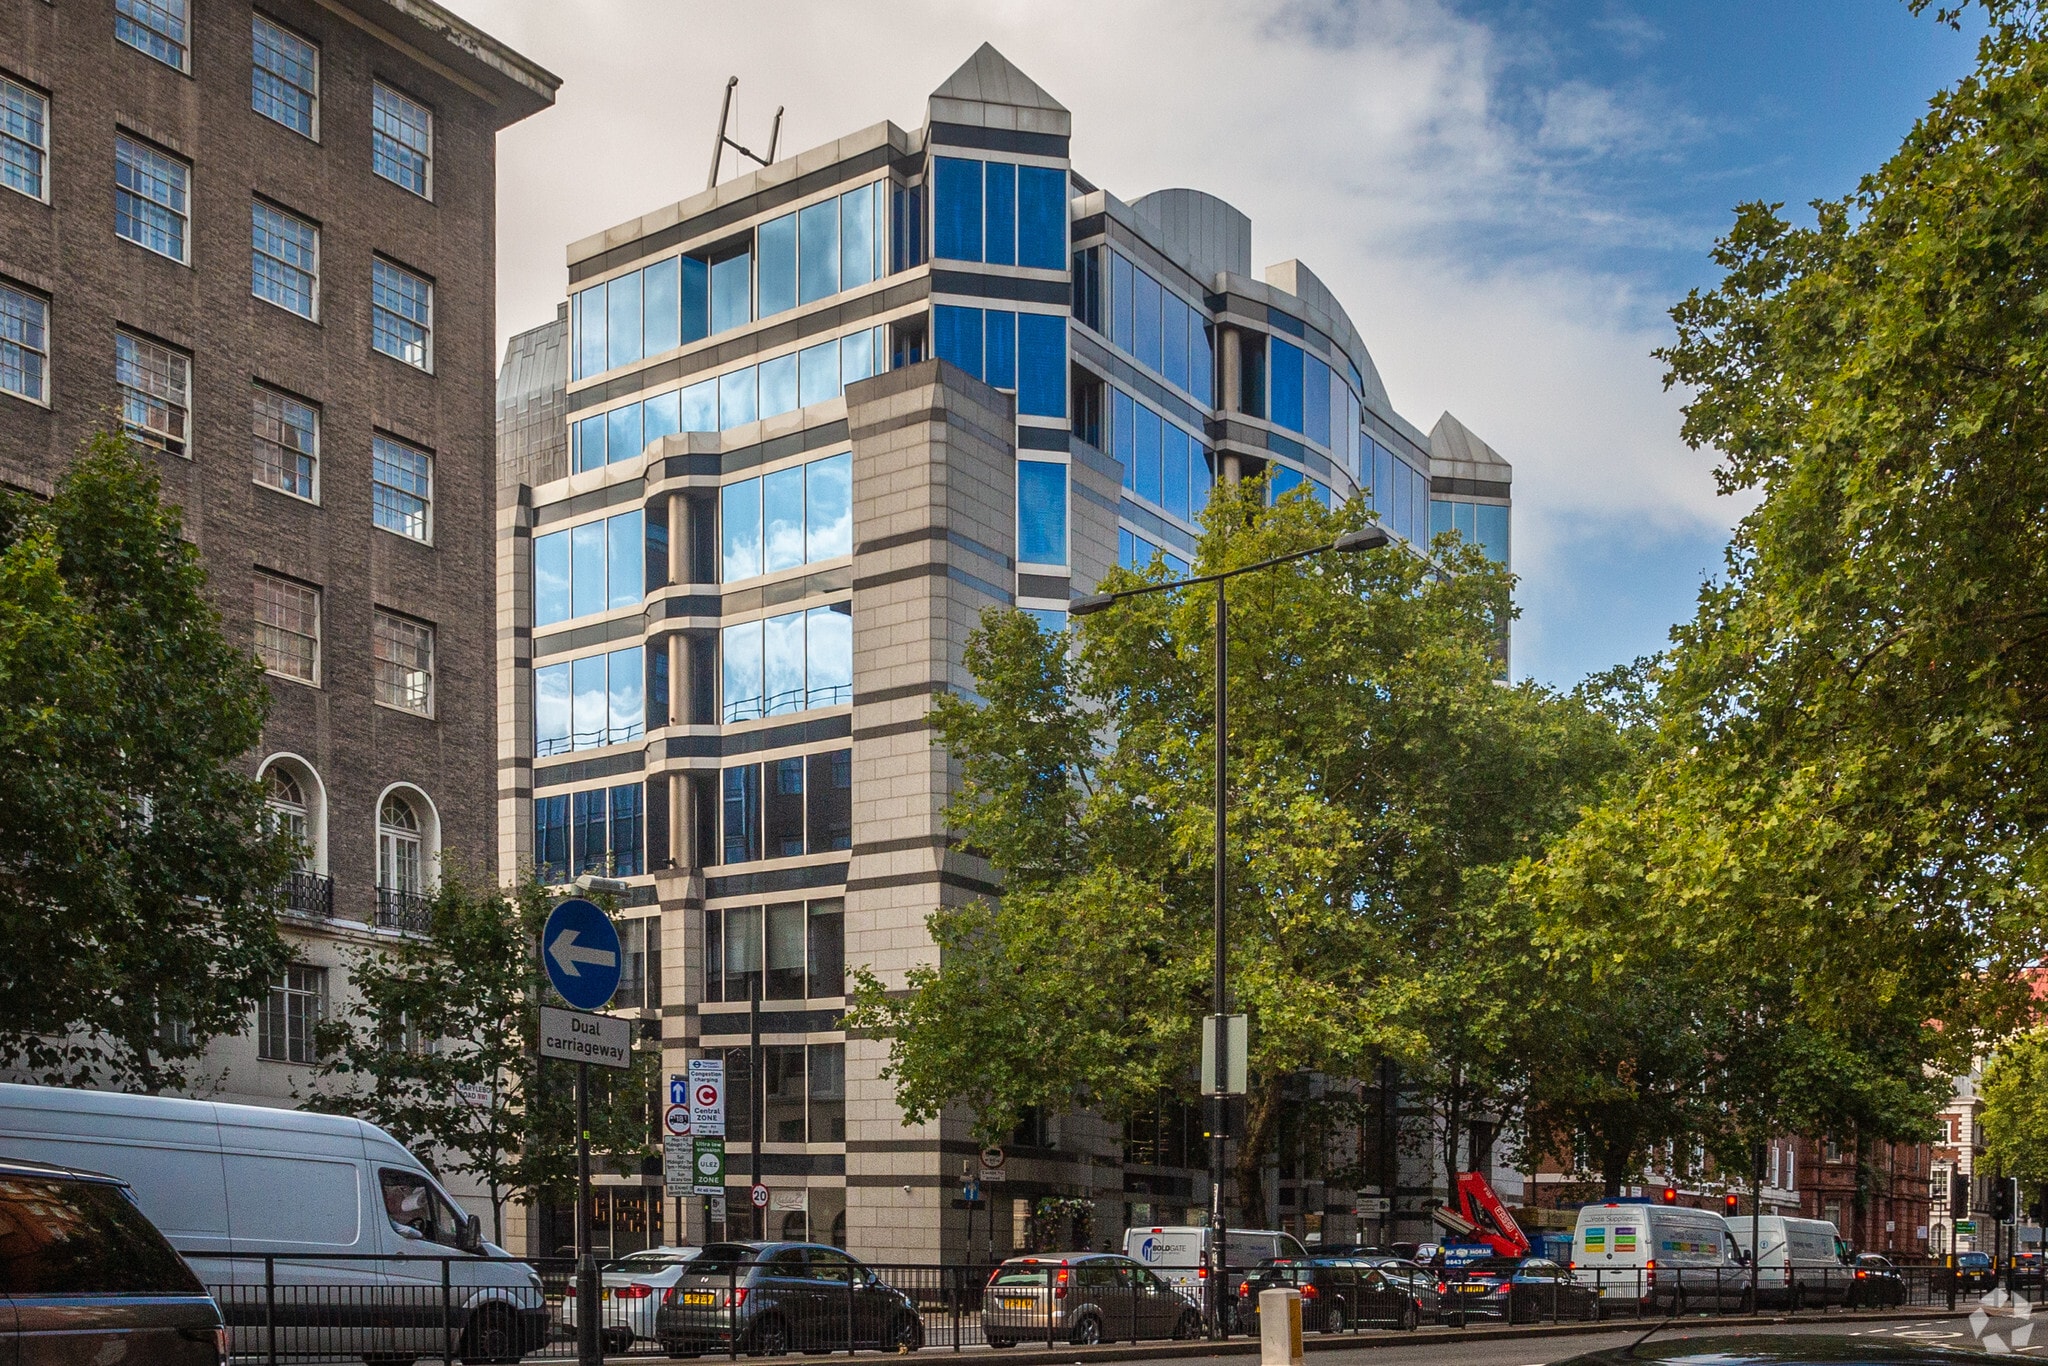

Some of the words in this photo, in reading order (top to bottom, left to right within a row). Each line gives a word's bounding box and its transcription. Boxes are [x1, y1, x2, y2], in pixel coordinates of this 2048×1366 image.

[571, 1018, 600, 1036] Dual
[546, 1037, 624, 1061] carriageway
[459, 1084, 491, 1093] MARYLEBO
[753, 1190, 767, 1201] 20
